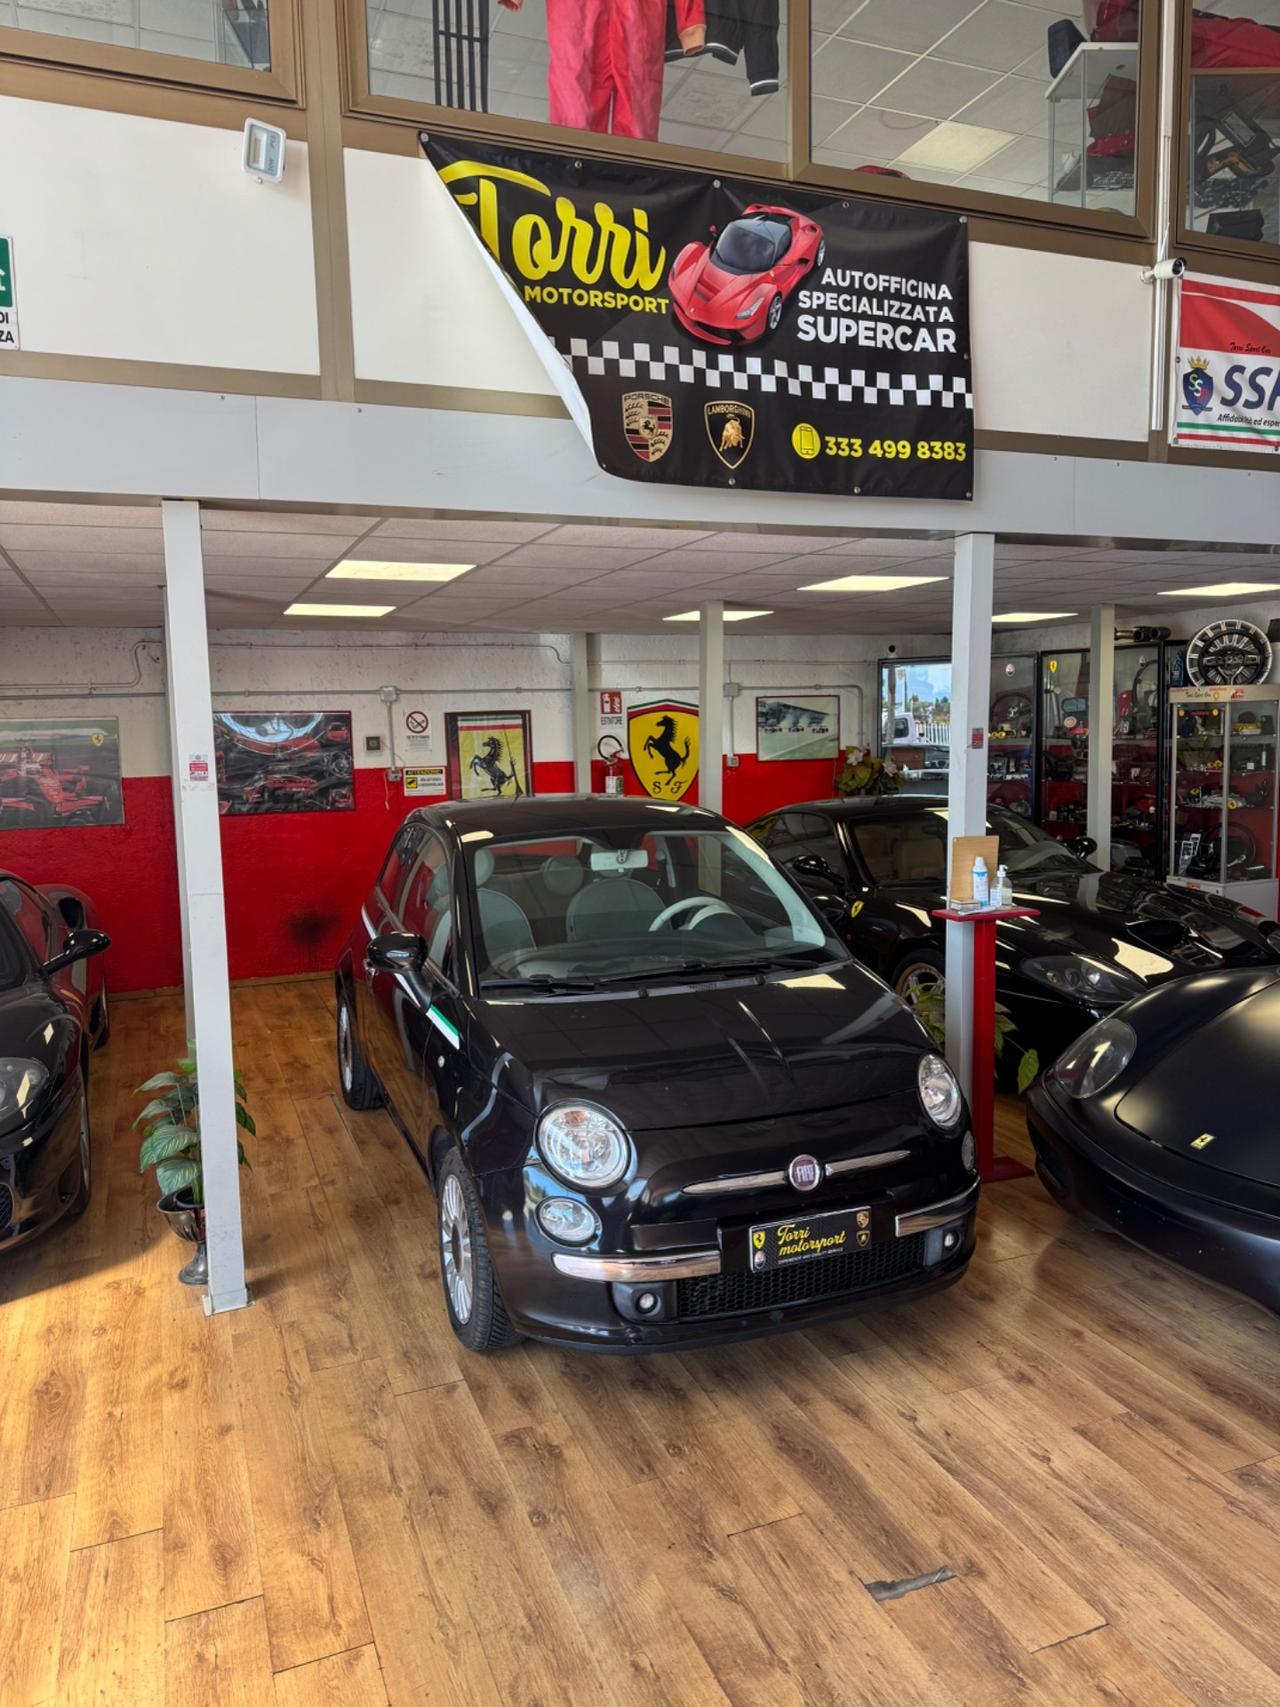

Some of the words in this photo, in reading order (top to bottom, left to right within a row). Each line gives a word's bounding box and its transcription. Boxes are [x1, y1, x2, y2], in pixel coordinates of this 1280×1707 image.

[438, 160, 666, 291] Torri
[821, 267, 953, 300] AUTOFFICINA
[524, 285, 669, 314] MOTORSPORT
[798, 290, 954, 323] SPECIALIZZATA
[797, 314, 957, 353] SUPERCAR
[624, 392, 670, 405] PORSCHE
[825, 436, 863, 457] 333
[868, 440, 911, 459] 499
[917, 441, 966, 461] 8383
[777, 1224, 810, 1244] Torri
[778, 1231, 846, 1256] motorsport
